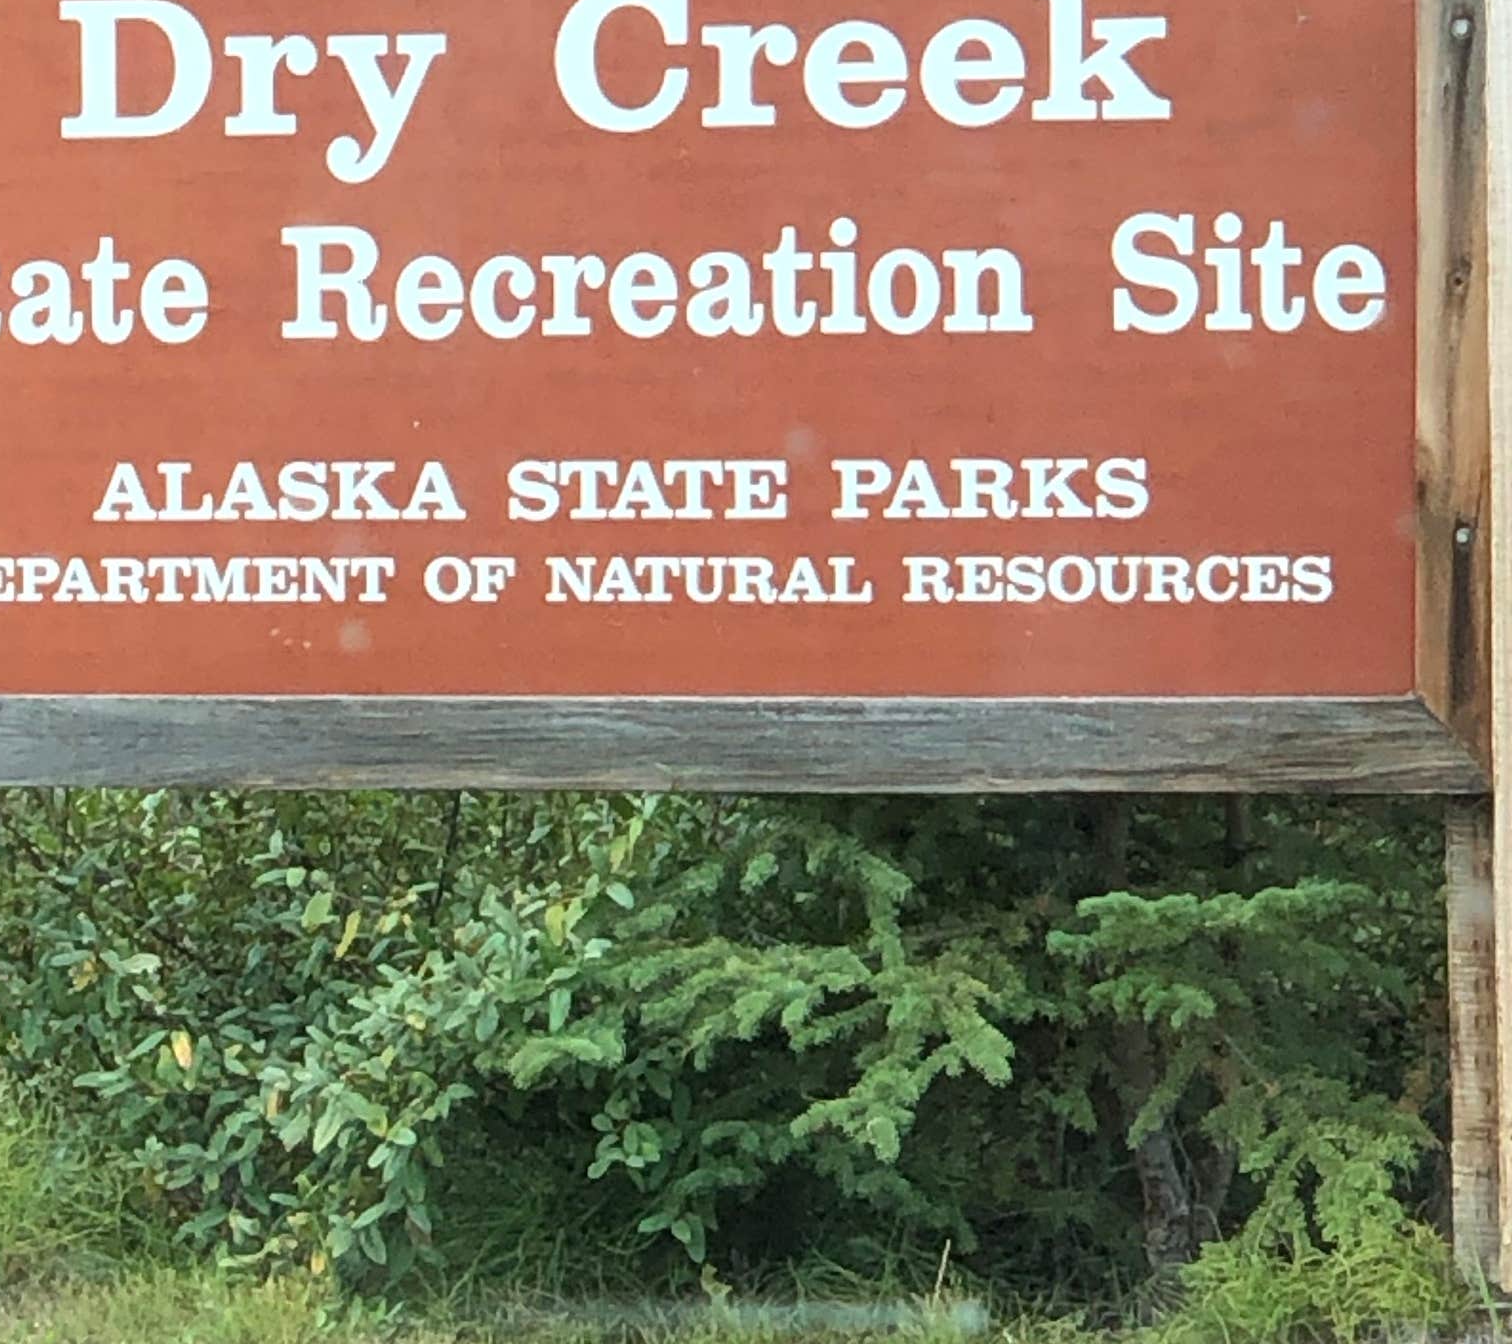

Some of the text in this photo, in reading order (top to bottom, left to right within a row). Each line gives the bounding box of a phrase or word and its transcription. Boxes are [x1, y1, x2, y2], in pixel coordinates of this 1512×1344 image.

[280, 215, 1035, 343] Recreation
[1111, 210, 1389, 335] Site
[92, 457, 1150, 523] ALASKA STATE PARKS
[423, 555, 517, 604] OF
[544, 555, 874, 605] NATURAL
[901, 554, 1334, 605] RESOURCES
